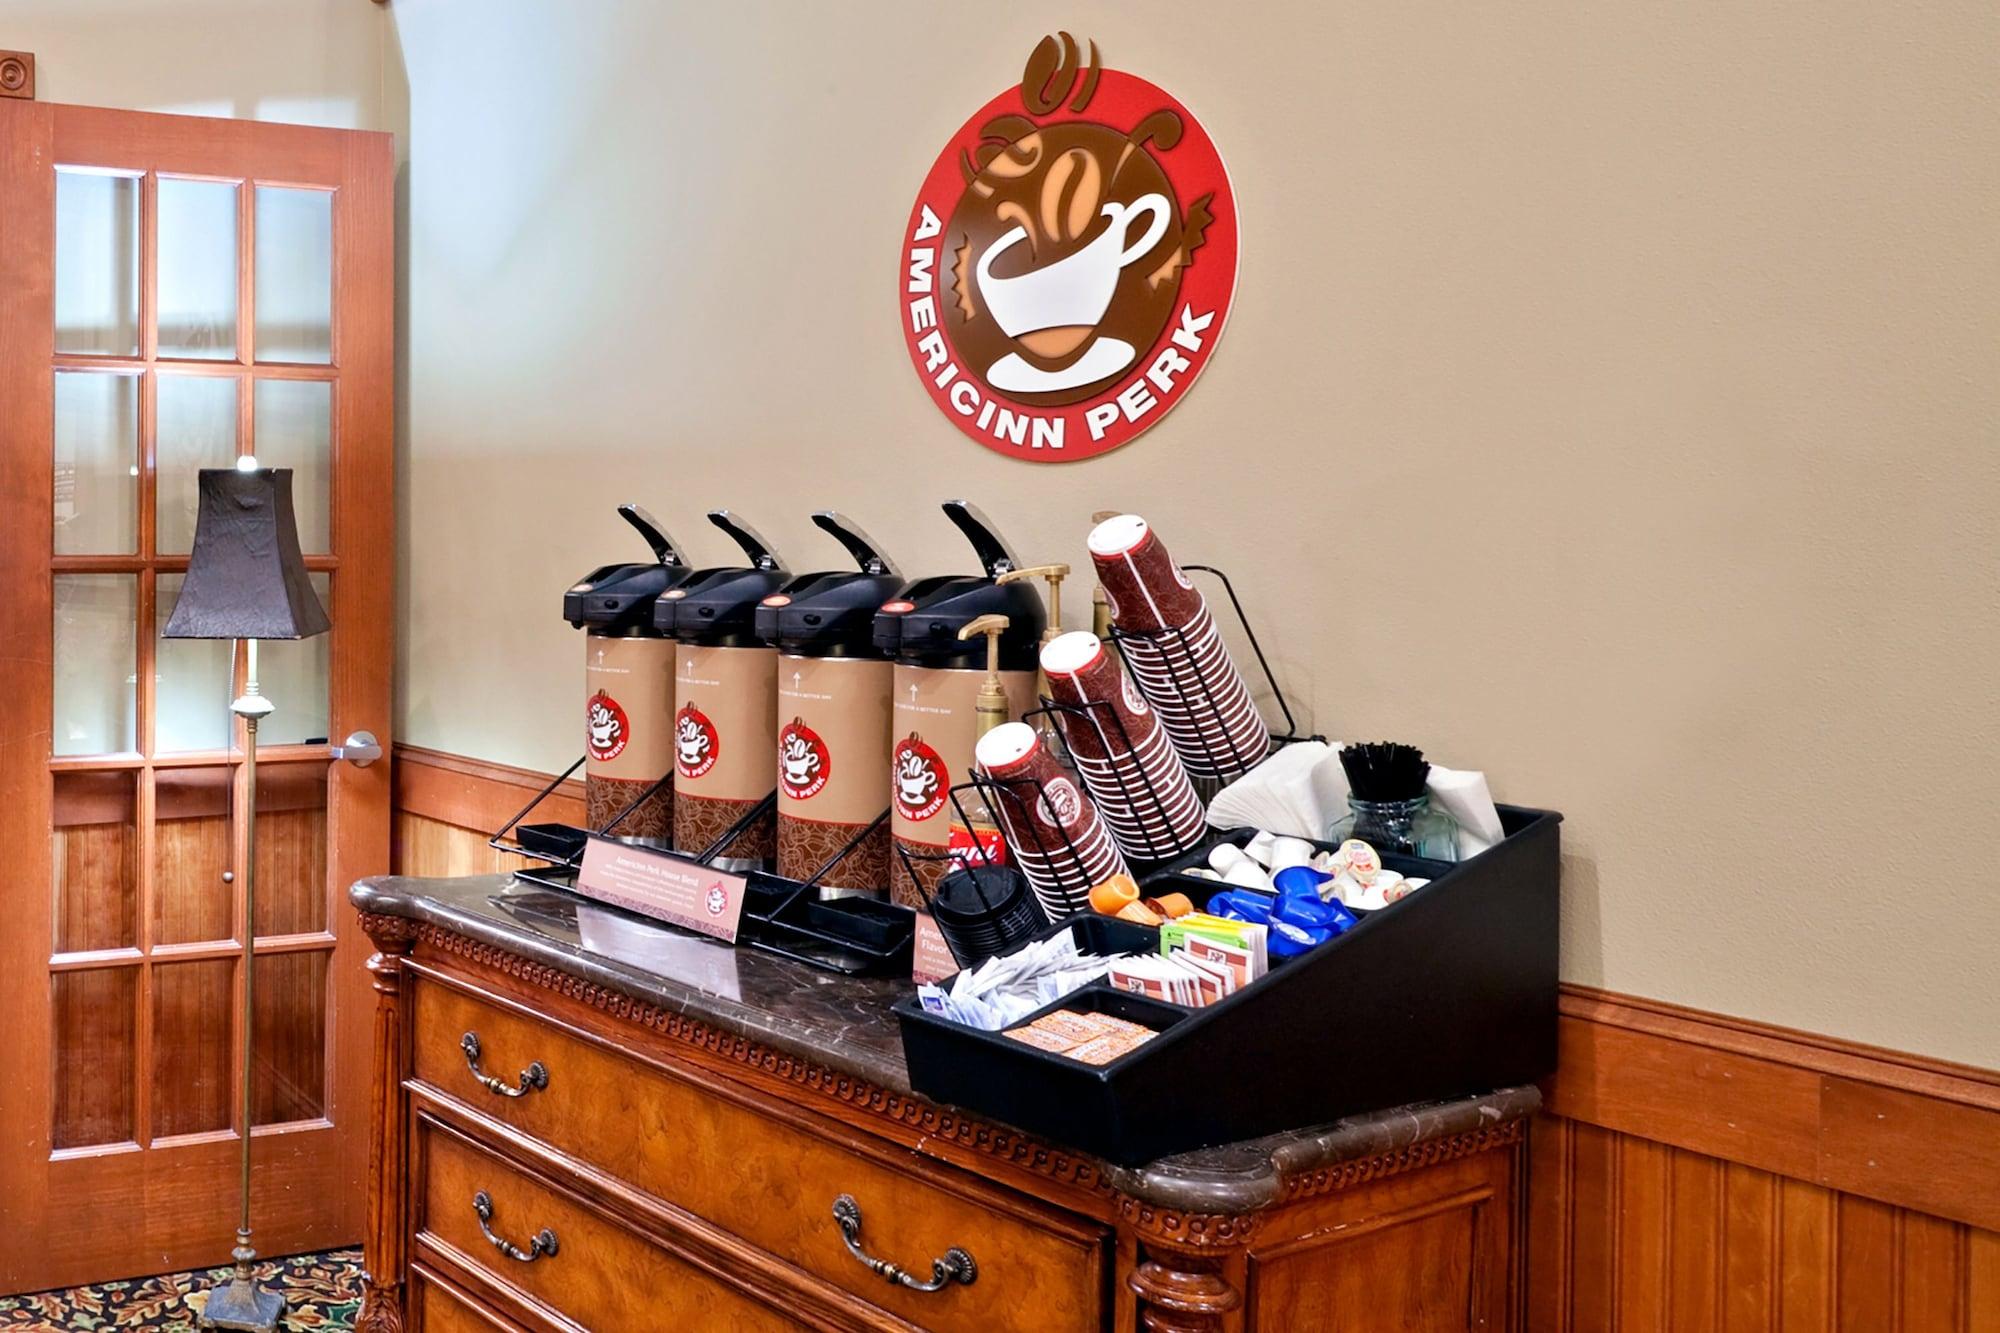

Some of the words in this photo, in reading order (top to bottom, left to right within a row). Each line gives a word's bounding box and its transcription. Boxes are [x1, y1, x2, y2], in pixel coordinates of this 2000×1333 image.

[908, 204, 1065, 449] AMERICINN
[1085, 303, 1215, 440] PERK
[799, 776, 826, 798] PERK
[915, 796, 944, 819] PERK
